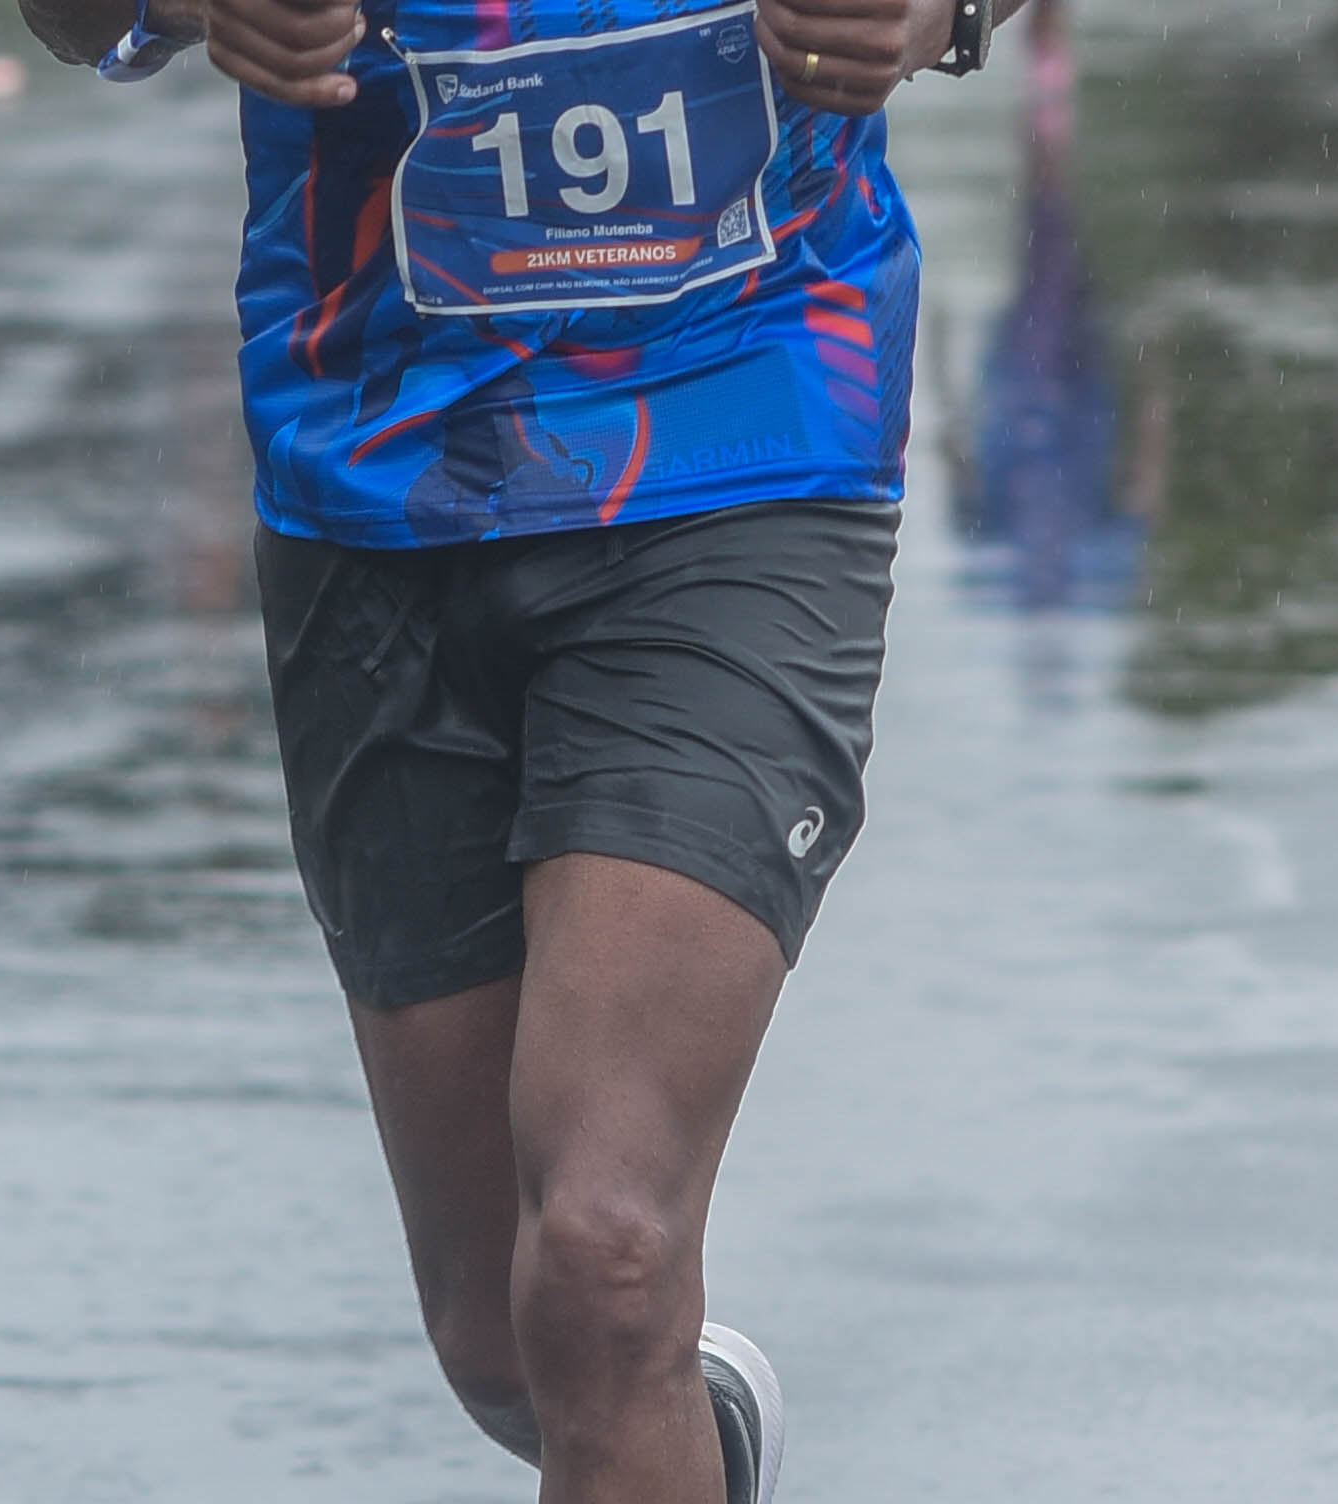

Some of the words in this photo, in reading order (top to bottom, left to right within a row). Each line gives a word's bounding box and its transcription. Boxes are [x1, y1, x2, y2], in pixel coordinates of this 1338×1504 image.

[507, 73, 543, 90] Bank
[472, 91, 695, 218] 191
[594, 223, 653, 237] Mutemba
[526, 251, 570, 268] 21KM
[575, 245, 677, 264] VETERANOS
